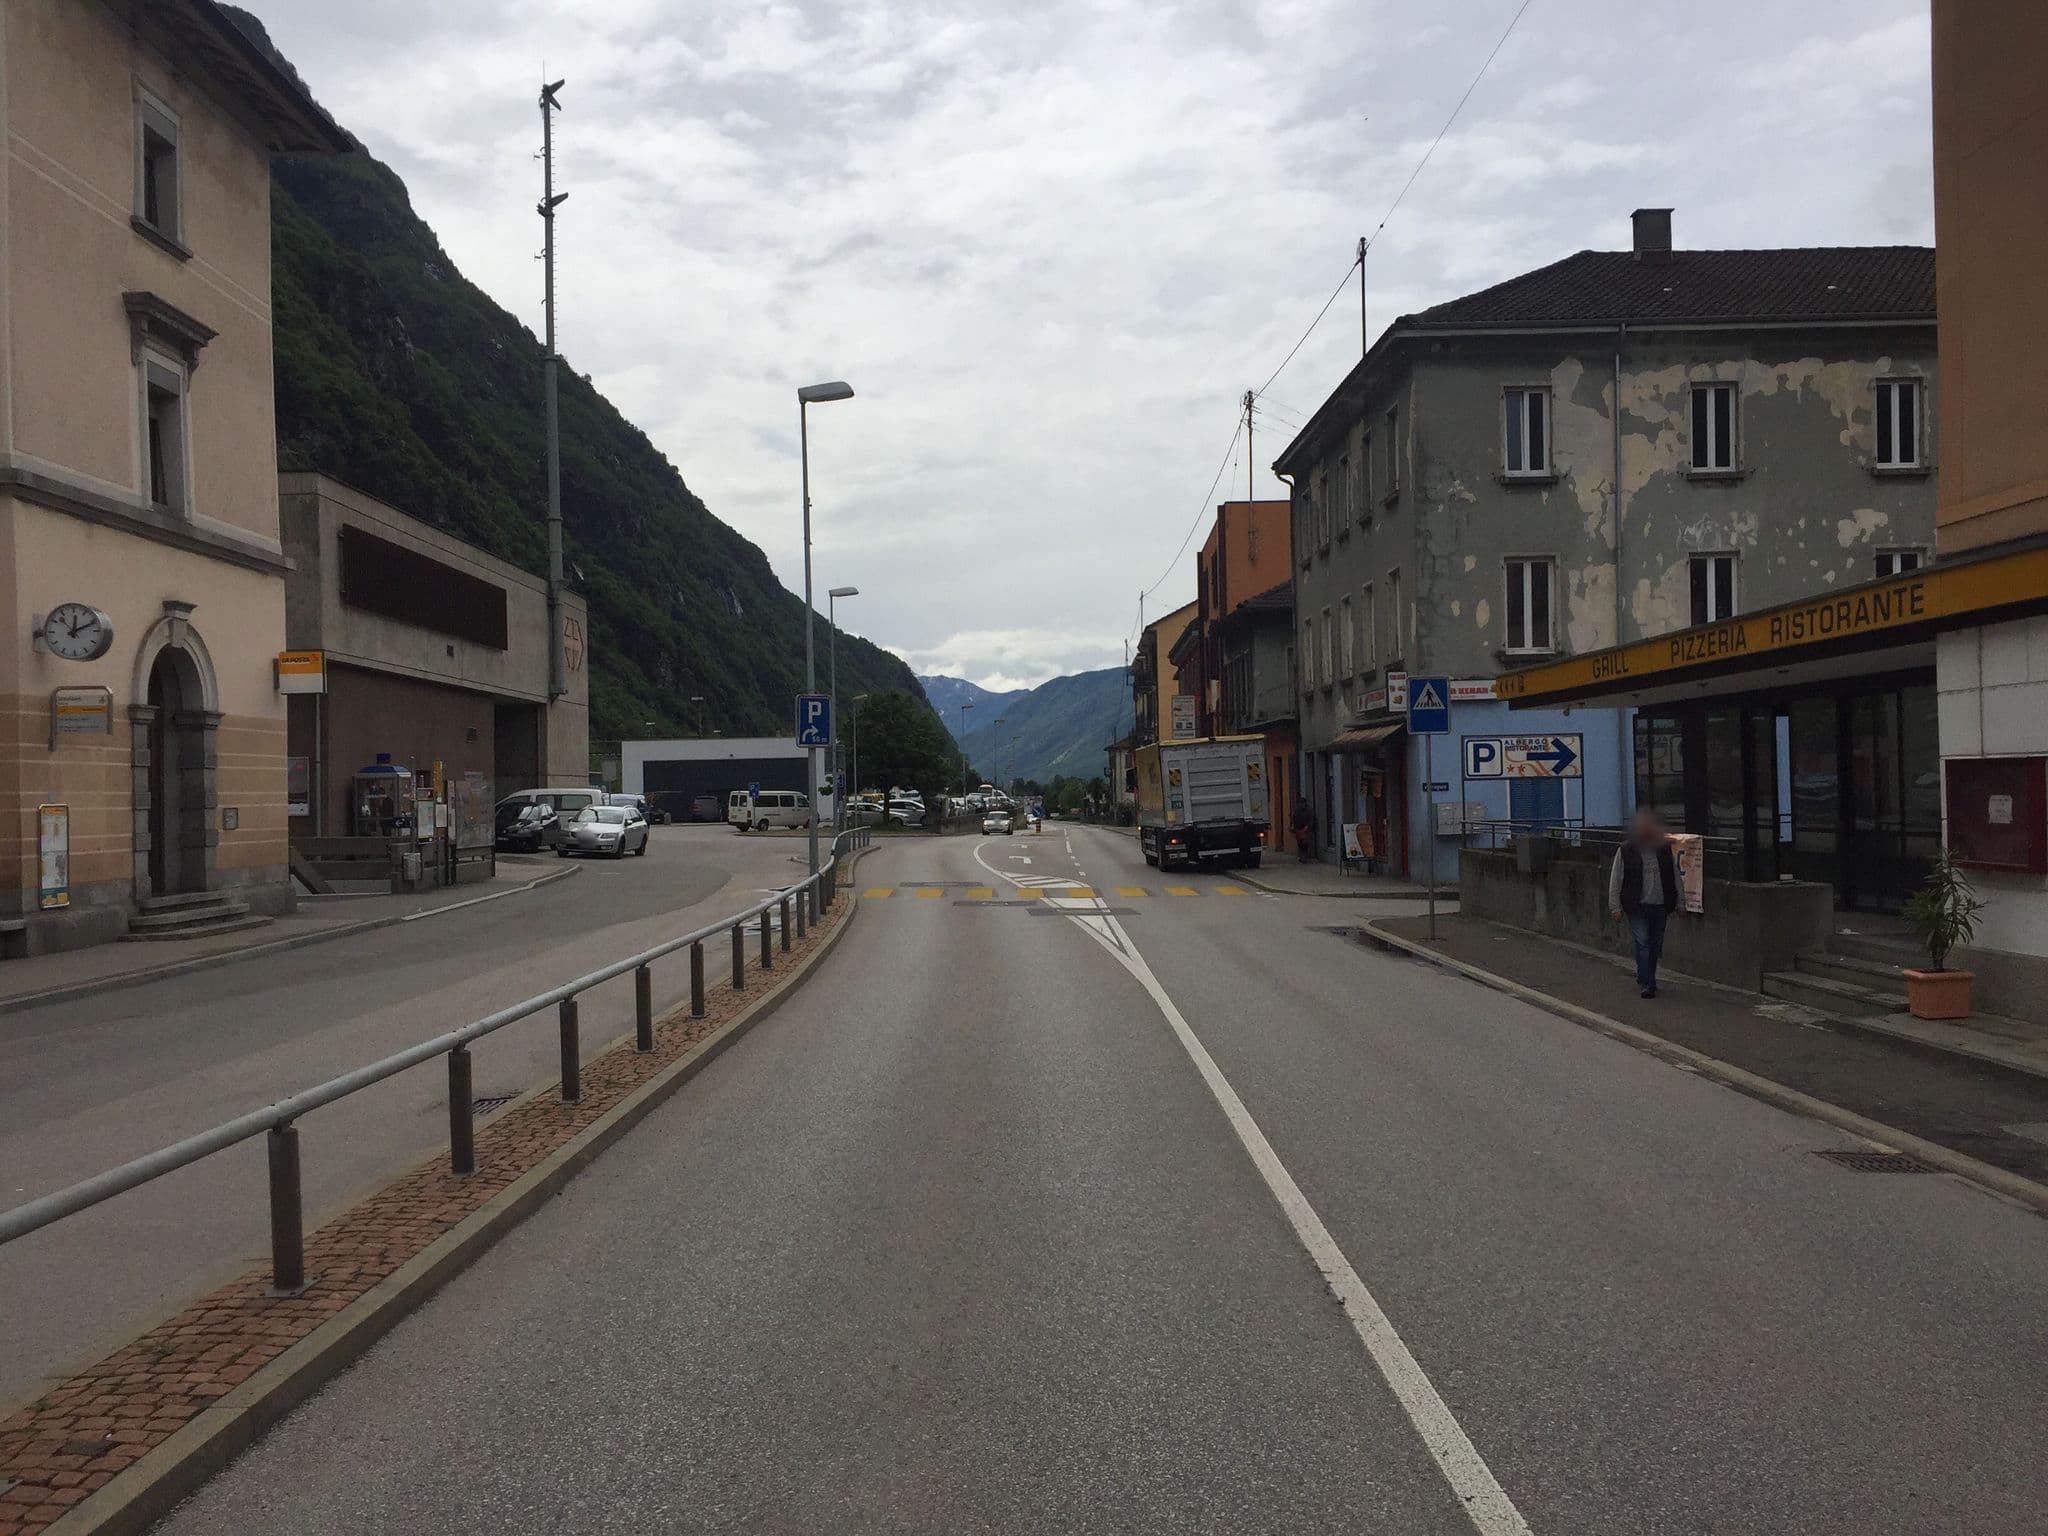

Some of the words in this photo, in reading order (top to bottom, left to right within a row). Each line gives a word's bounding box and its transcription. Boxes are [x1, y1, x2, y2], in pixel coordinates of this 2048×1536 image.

[1592, 650, 1629, 679] GRILL
[1670, 624, 1747, 664] PIZZERIA
[1770, 583, 1925, 644] RISTORANTE
[808, 701, 822, 723] P
[1473, 743, 1496, 773] P
